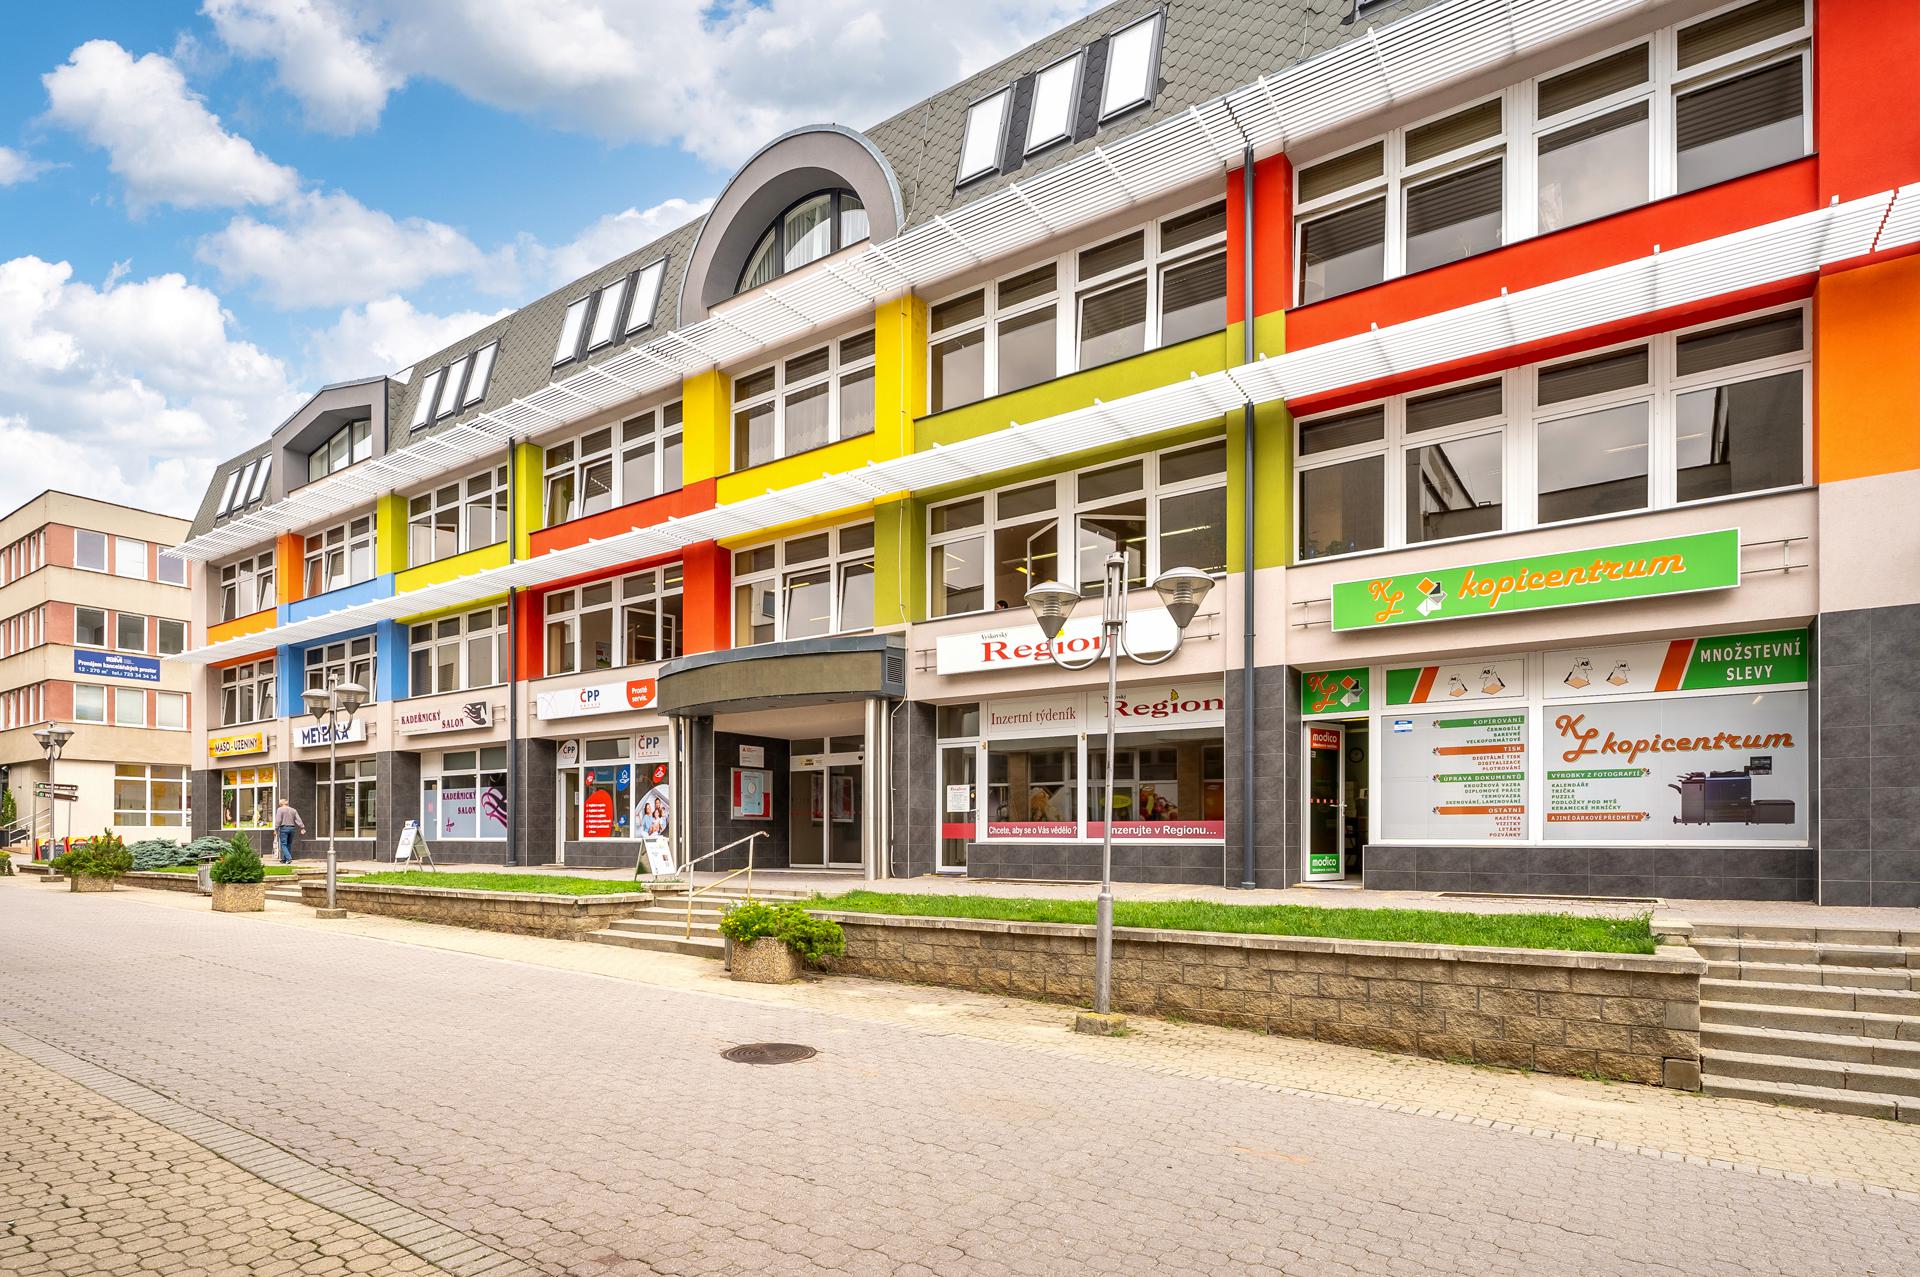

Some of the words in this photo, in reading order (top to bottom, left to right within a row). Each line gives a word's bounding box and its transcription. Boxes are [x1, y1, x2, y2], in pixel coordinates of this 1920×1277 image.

[1458, 554, 1686, 608] kopicentrum
[981, 634, 1114, 662] Region
[1700, 637, 1800, 663] MNOŽSTEVNÍ
[1726, 665, 1773, 681] SLEVY
[580, 688, 600, 702] ČPP
[1104, 698, 1224, 718] Region
[401, 709, 440, 724] KADEŘNICKÝ
[442, 718, 464, 728] SALON
[991, 712, 1032, 725] Inzertní
[1036, 707, 1076, 725] týdeník
[1473, 717, 1521, 725] KOPÍROVÁNÍ
[638, 734, 659, 749] ČPP
[1312, 732, 1337, 743] modico
[215, 741, 230, 752] MASO
[234, 738, 257, 751] UZENINY
[563, 745, 575, 754] ČPP
[1601, 731, 1794, 764] kopicentrum
[1475, 773, 1521, 781] DOKUMENTŮ
[442, 790, 476, 800] KADEŘNICKÝ
[458, 806, 476, 814] SALON
[988, 826, 1011, 836] Chcete,
[1012, 826, 1023, 837] aby
[1038, 826, 1049, 834] Vás
[1050, 826, 1072, 834] vědělo
[1073, 826, 1078, 834] ?
[1111, 826, 1151, 836] nzerujte
[1312, 856, 1337, 866] modico
